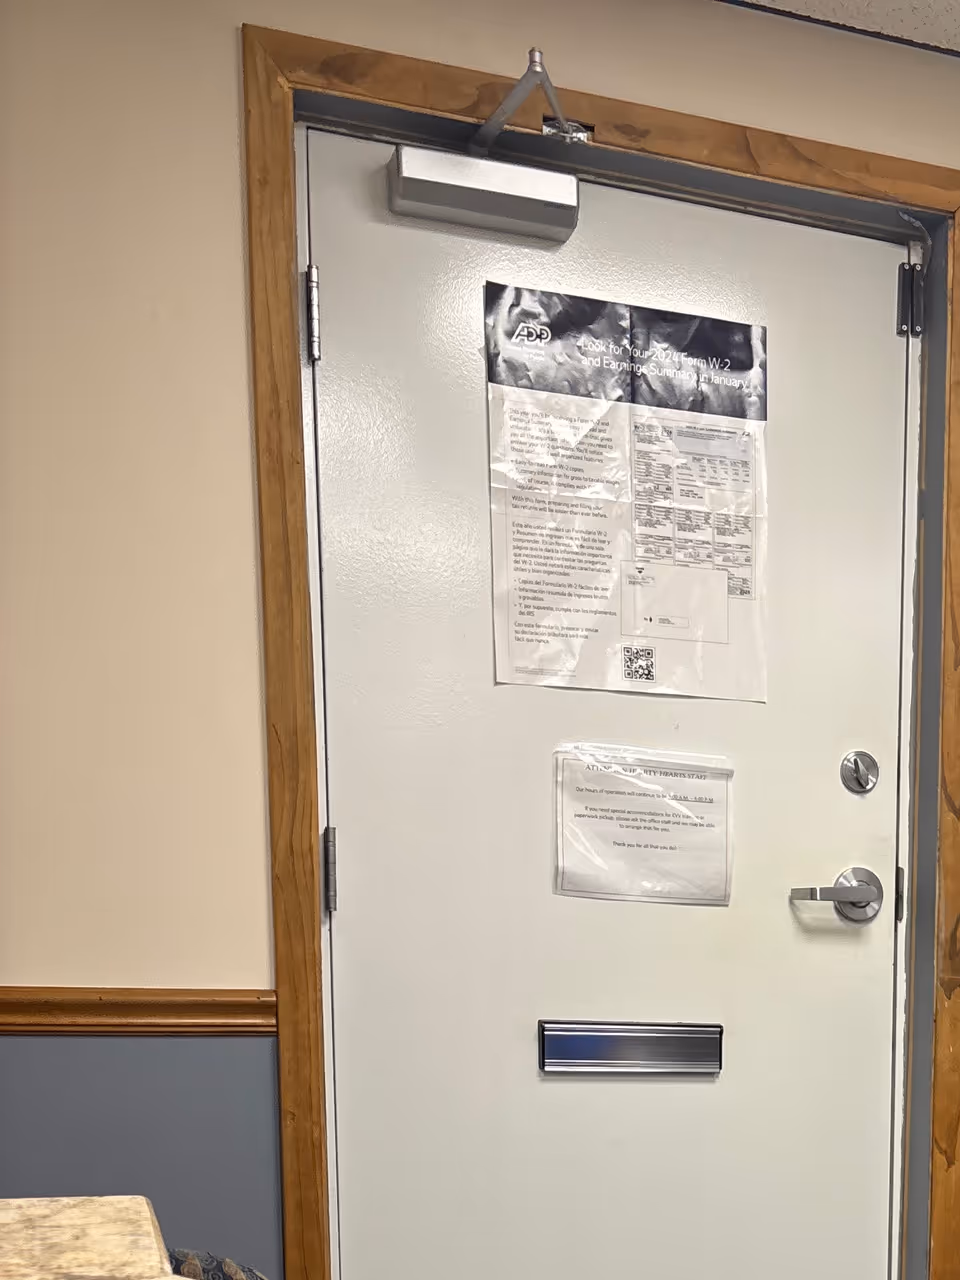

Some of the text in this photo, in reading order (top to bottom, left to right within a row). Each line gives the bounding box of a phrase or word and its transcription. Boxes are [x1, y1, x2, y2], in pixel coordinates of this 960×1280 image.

[511, 322, 552, 345] ADP
[582, 342, 730, 371] Look for Your 2024 Form W-2
[582, 357, 747, 389] and Earnings Summary in January
